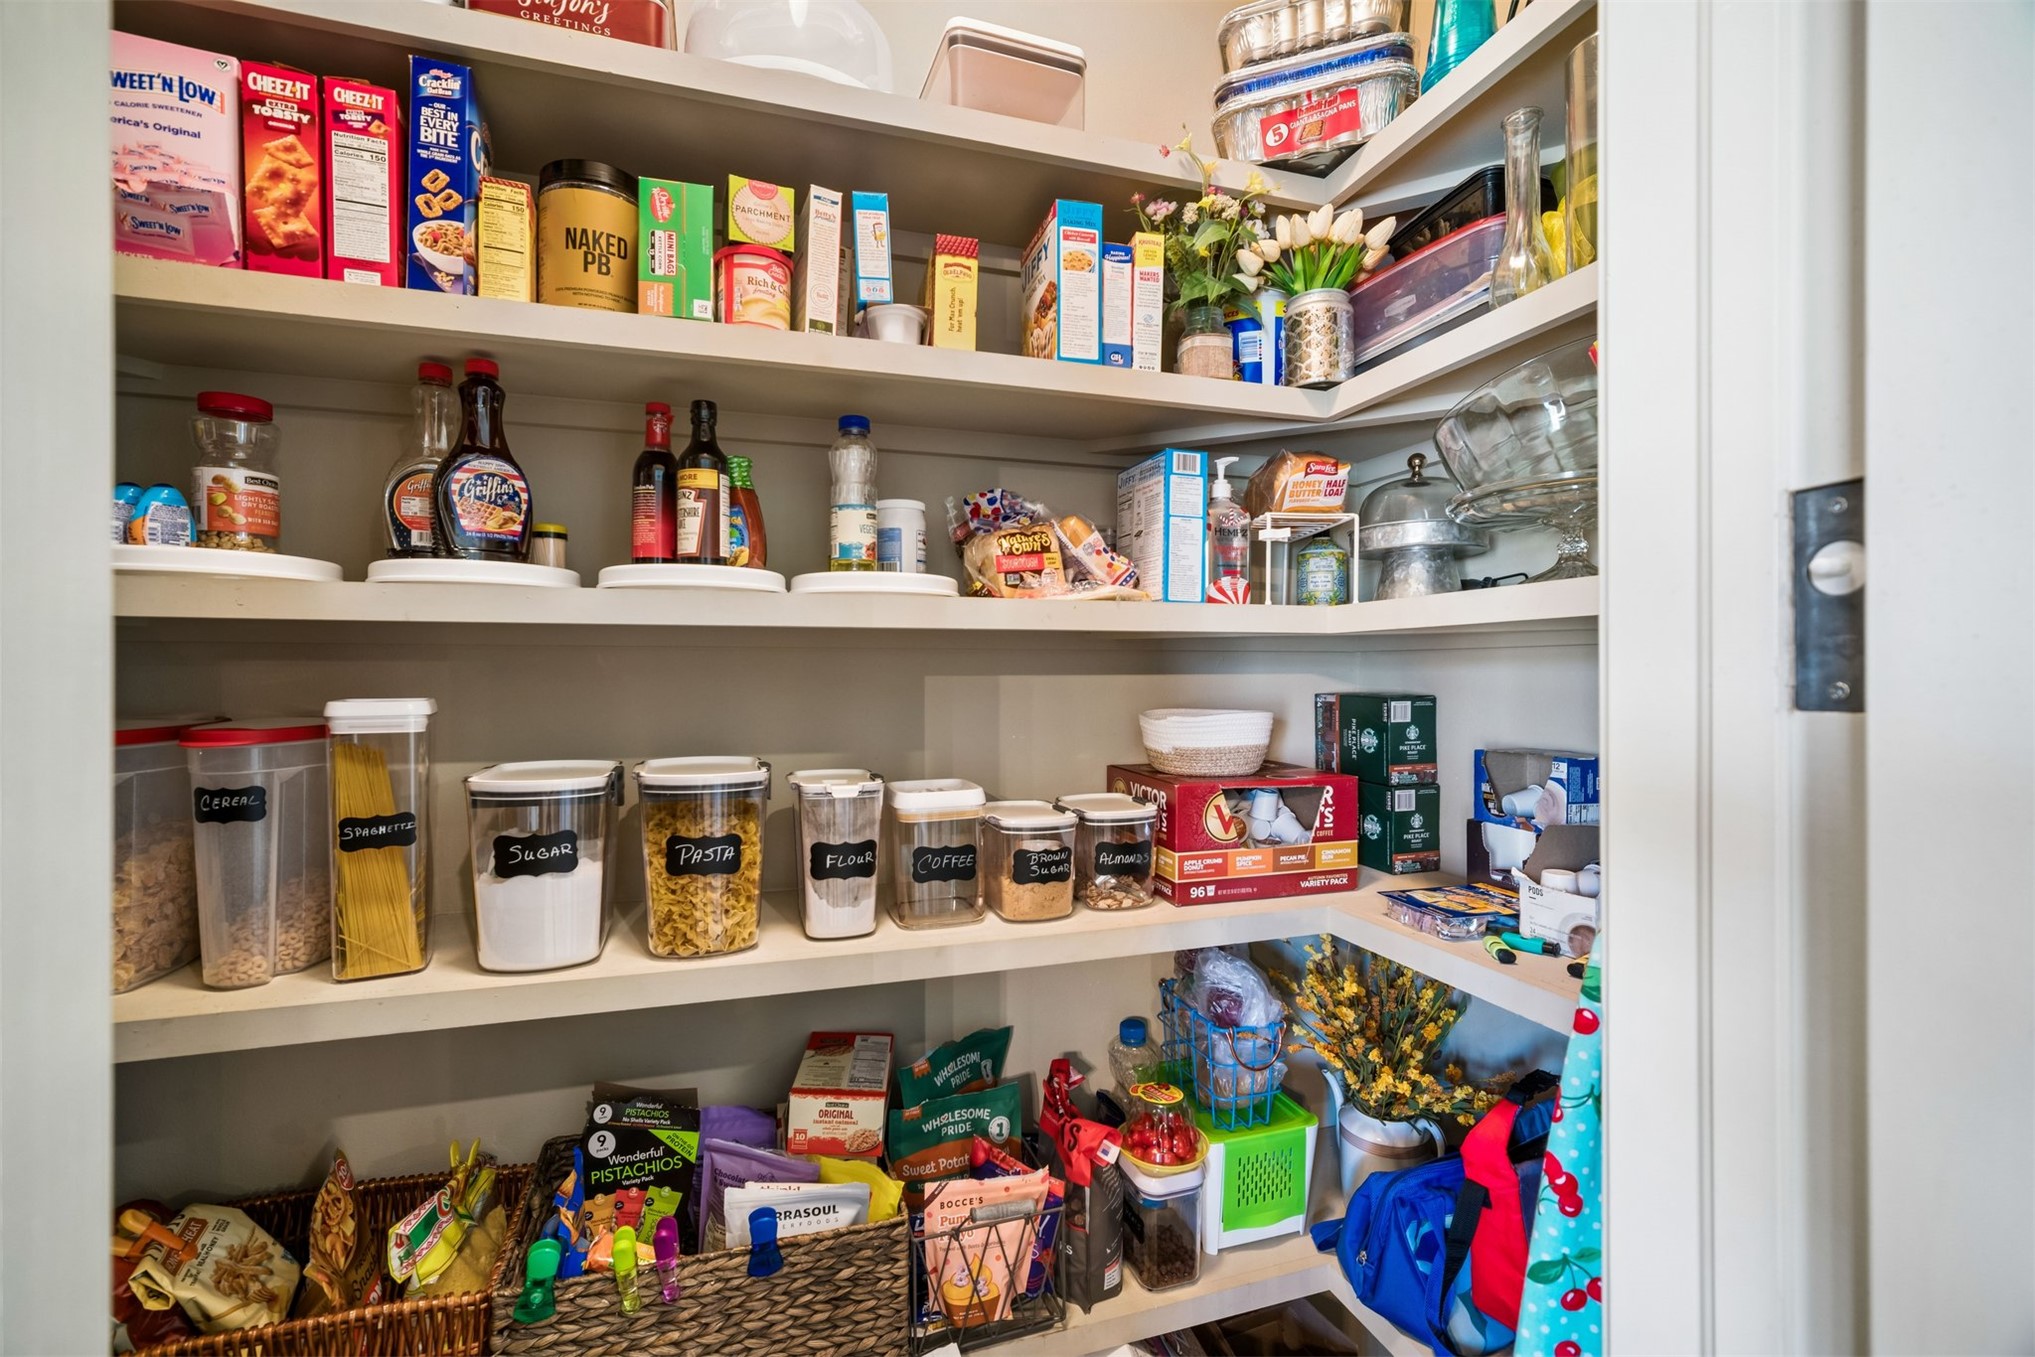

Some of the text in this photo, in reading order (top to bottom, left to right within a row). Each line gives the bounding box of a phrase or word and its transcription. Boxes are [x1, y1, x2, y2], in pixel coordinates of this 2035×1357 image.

[520, 10, 611, 36] GREETINGS
[110, 70, 174, 93] WEET'N
[151, 103, 203, 118] SWEETENER
[421, 106, 458, 122] BEST IN
[1290, 100, 1356, 130] GIANT LASAGNA PANS
[153, 122, 201, 139] Original
[420, 115, 459, 132] EVERY
[420, 126, 459, 148] BITE
[1271, 126, 1284, 144] 5
[334, 149, 387, 163] Calories 150
[512, 204, 525, 214] 150
[735, 204, 791, 223] PARCHMENT
[565, 226, 628, 260] NAKED
[666, 233, 675, 274] MINI BAGS
[583, 250, 611, 276] PB
[1021, 236, 1050, 294] JIFFY
[747, 276, 777, 292] Rich &
[1307, 462, 1325, 473] Sara
[1118, 474, 1136, 489] JIFFY
[1291, 480, 1323, 489] HONEY
[1326, 479, 1346, 488] HALF
[464, 476, 514, 505] Griffin's
[1289, 488, 1322, 498] BUTTER
[1323, 488, 1344, 497] LOAF
[234, 494, 267, 504] LIGHTLY
[241, 501, 258, 509] DRY
[1214, 527, 1249, 537] HEMPZ
[998, 532, 1051, 552] Nature's
[1011, 541, 1041, 555] Own
[200, 794, 260, 811] CEREAL
[1130, 781, 1167, 811] VICTOR
[340, 820, 416, 841] SPAGHETTI
[1316, 829, 1334, 837] COFFEE
[508, 843, 574, 865] SUGAR
[674, 843, 736, 867] PASTA
[825, 849, 875, 870] FLOUR
[1027, 851, 1069, 865] BROWN
[1099, 851, 1151, 866] ALMONDS
[917, 853, 976, 875] COFFEE
[1029, 863, 1071, 877] SUGAR
[1300, 877, 1349, 888] VARIETY PACK
[1190, 886, 1206, 899] 96
[1528, 885, 1544, 897] PODS
[950, 1068, 970, 1089] PRIDE
[599, 1106, 607, 1116] 9
[624, 1108, 670, 1119] PISTACHIOS
[818, 1109, 854, 1120] ORIGINAL
[921, 1108, 991, 1133] WHOLESOME
[795, 1132, 806, 1140] 10
[941, 1121, 973, 1137] PRIDE
[596, 1134, 607, 1147] 9
[665, 1134, 694, 1157] PROTEIN
[608, 1145, 665, 1165] Wonderful
[591, 1155, 683, 1185] PISTACHIOS
[902, 1153, 971, 1177] Sweet Potat
[621, 1174, 655, 1186] Variety Pack
[939, 1196, 984, 1210] BOCCE'S
[181, 1220, 202, 1244] HEAT
